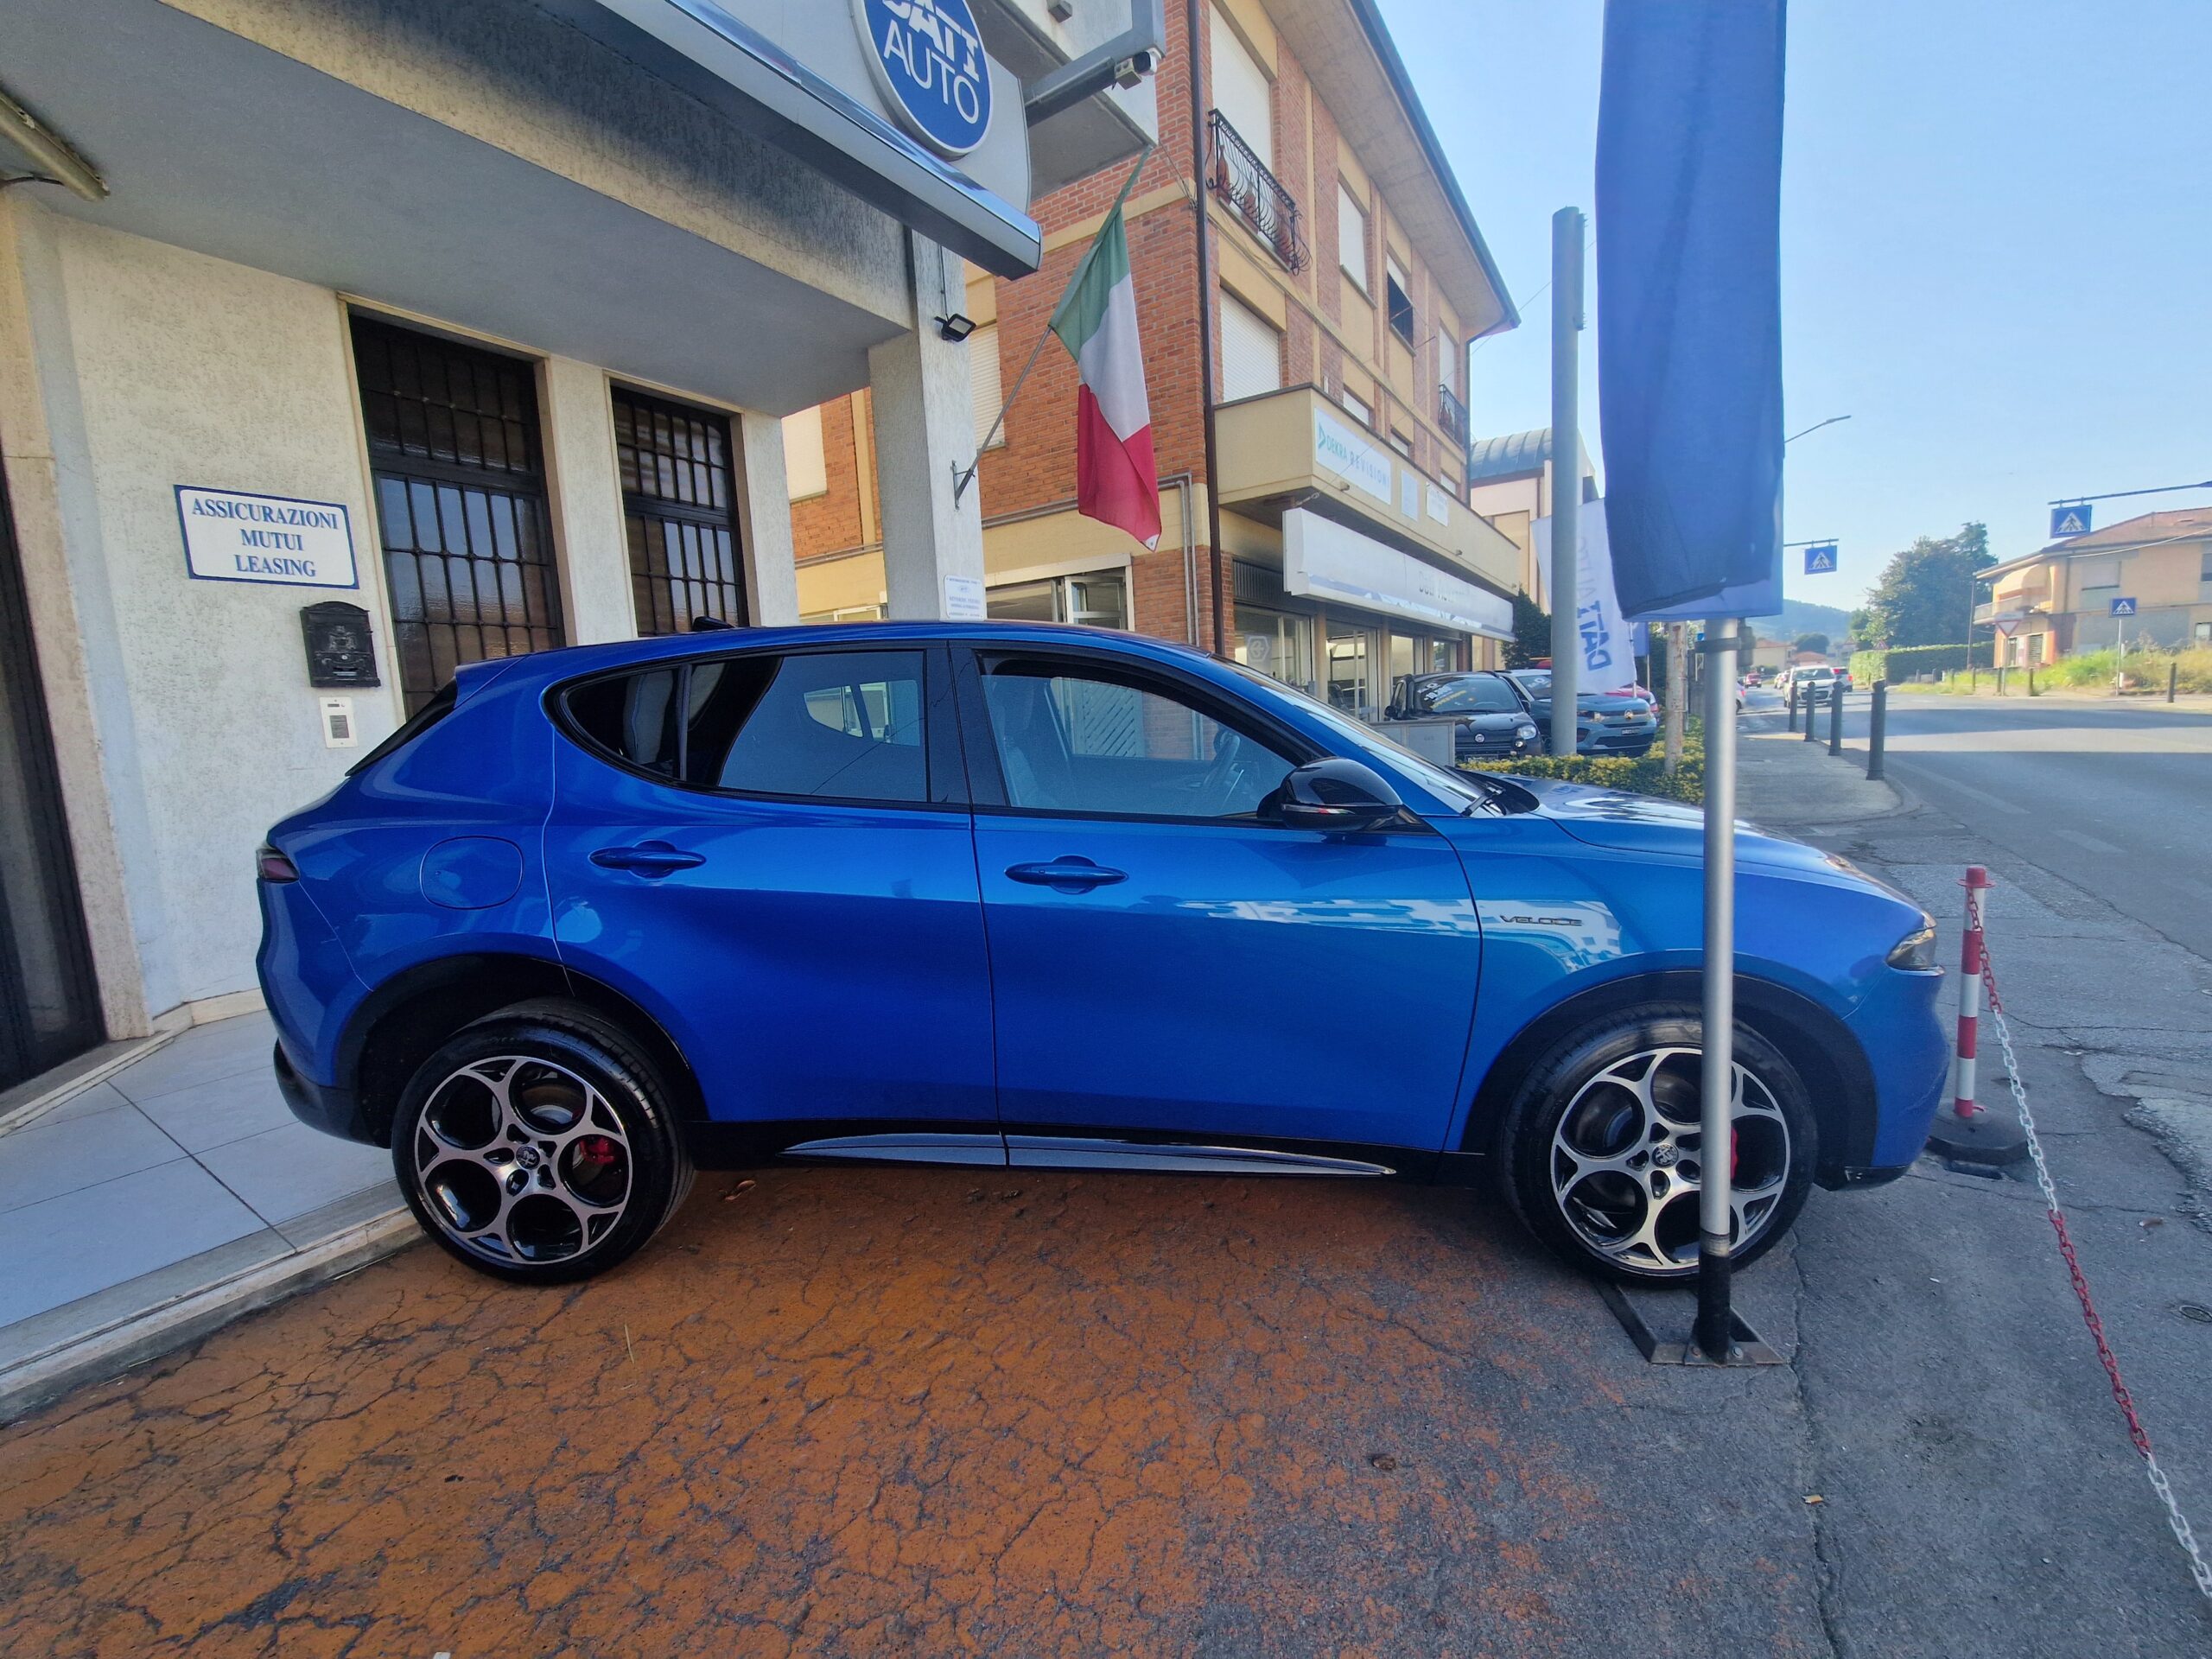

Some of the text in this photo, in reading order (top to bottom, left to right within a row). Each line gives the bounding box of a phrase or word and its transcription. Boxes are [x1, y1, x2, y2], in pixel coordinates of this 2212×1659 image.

[882, 0, 980, 83] ATI
[883, 19, 980, 124] AUTO
[1326, 435, 1348, 463] DEKRA
[192, 498, 339, 530] ASSICURAZIONI
[241, 530, 304, 550] MUTUI
[234, 555, 316, 576] LEASING
[1499, 914, 1582, 927] VELOCE
